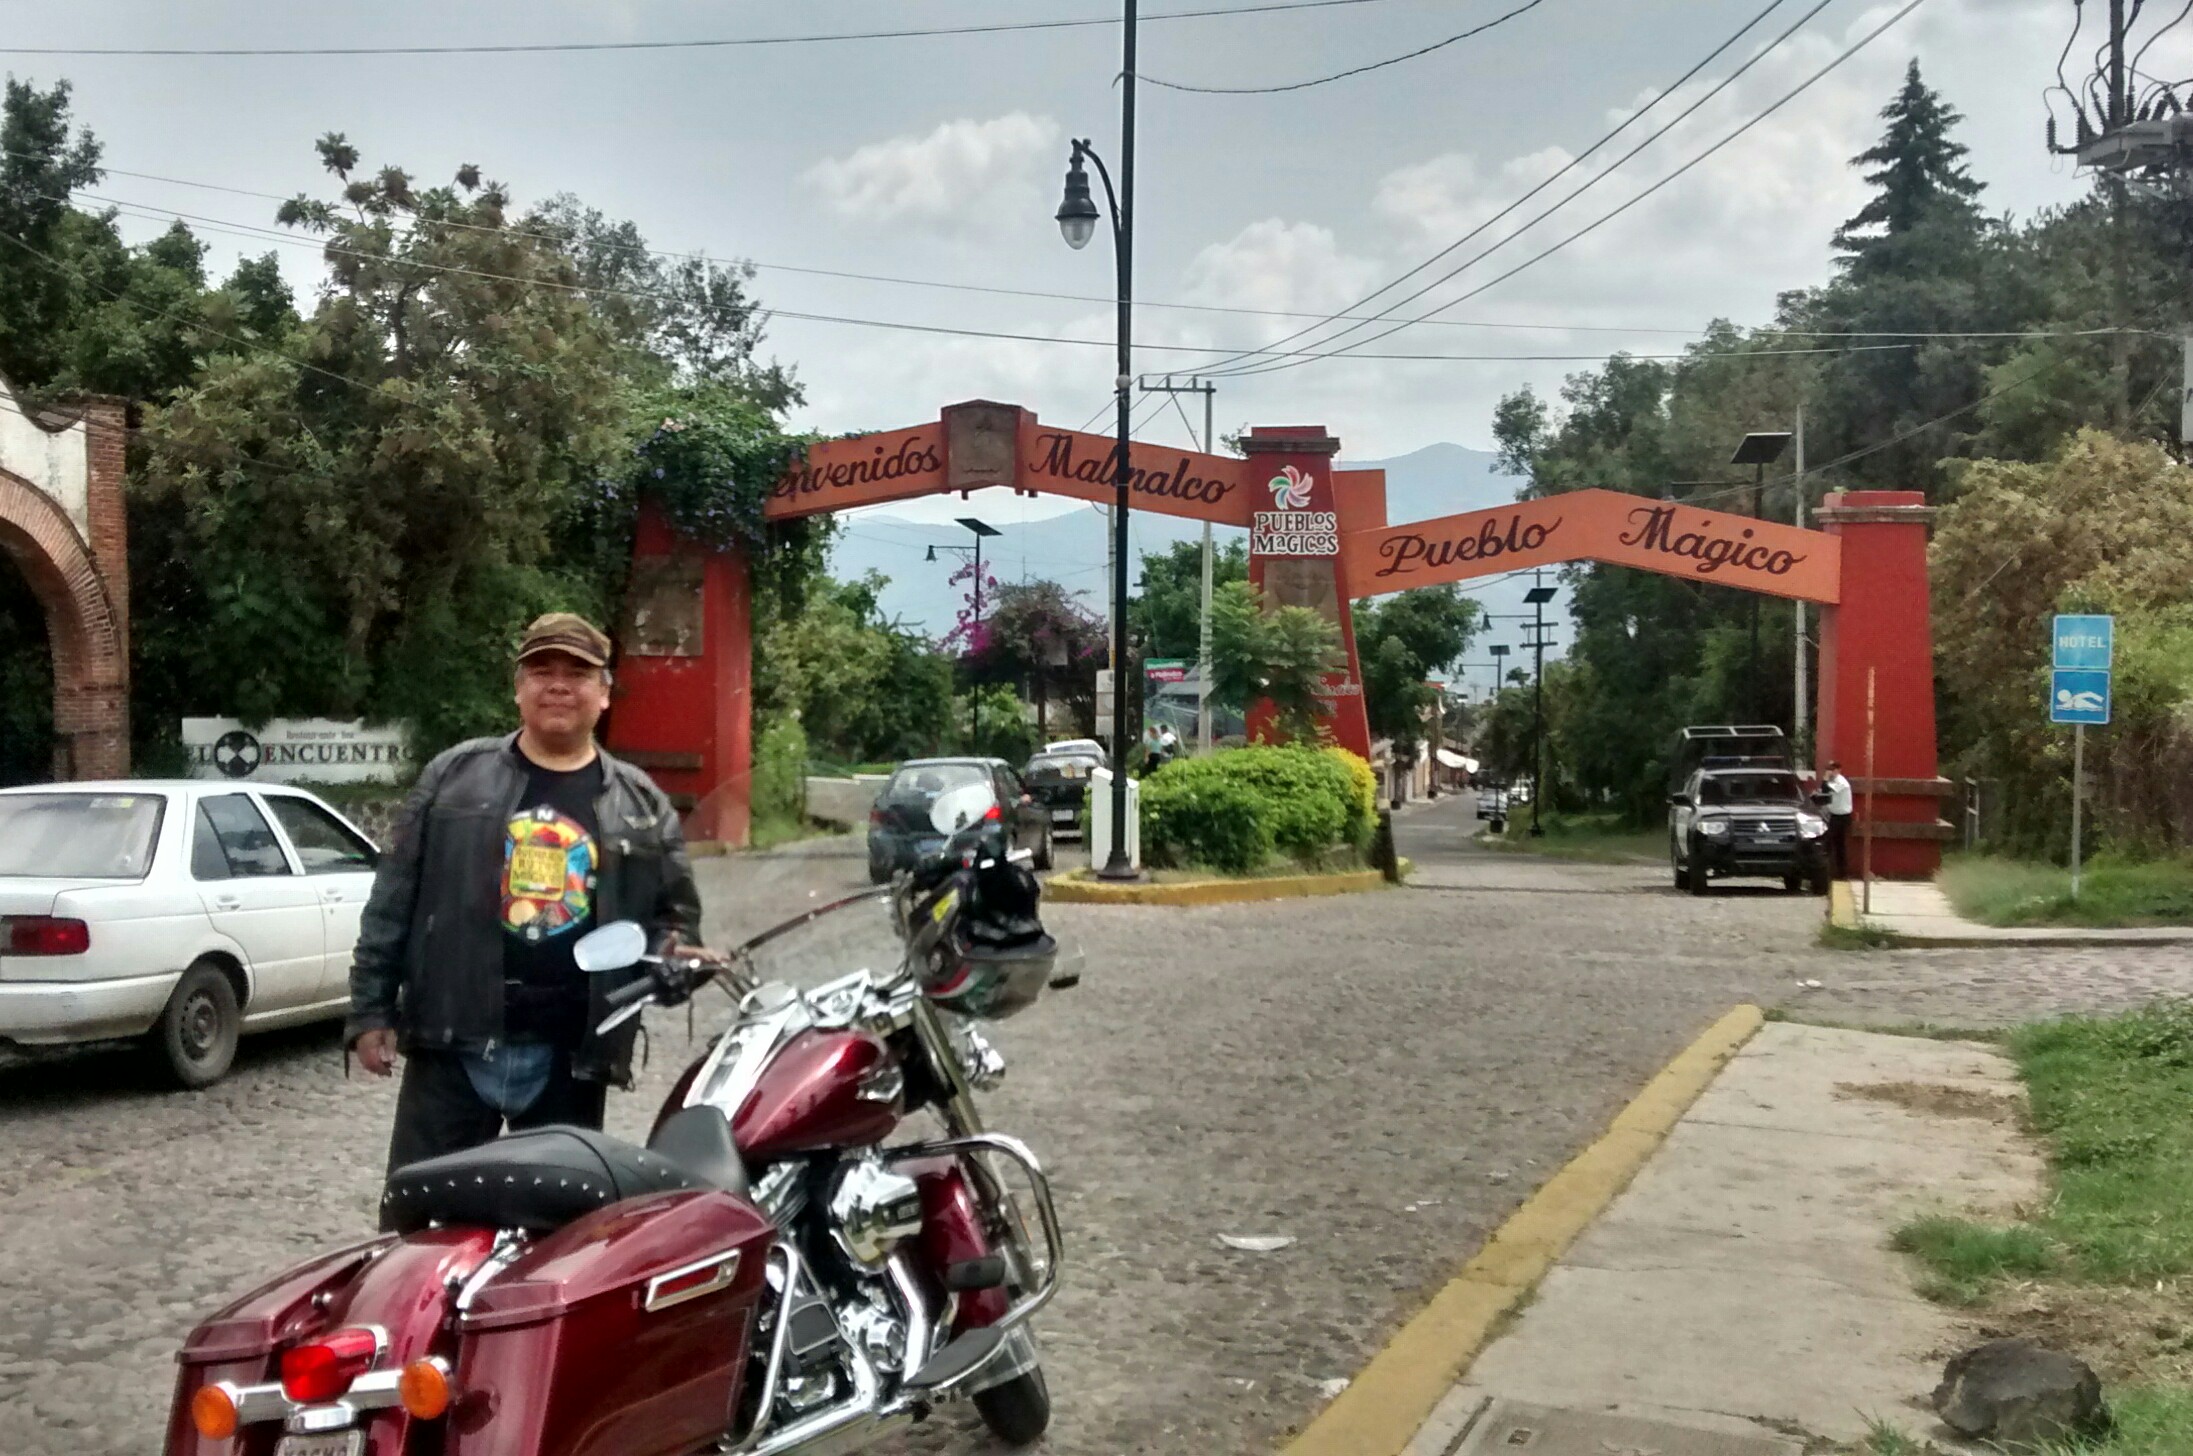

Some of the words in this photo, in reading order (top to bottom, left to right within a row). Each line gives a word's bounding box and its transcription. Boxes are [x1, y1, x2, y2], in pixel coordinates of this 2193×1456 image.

[770, 436, 942, 501] envenidos
[1029, 433, 1236, 504] Malnalco
[1375, 514, 1563, 577] Pueblo
[1618, 506, 1808, 575] Mágico
[2058, 636, 2107, 649] HOTEL
